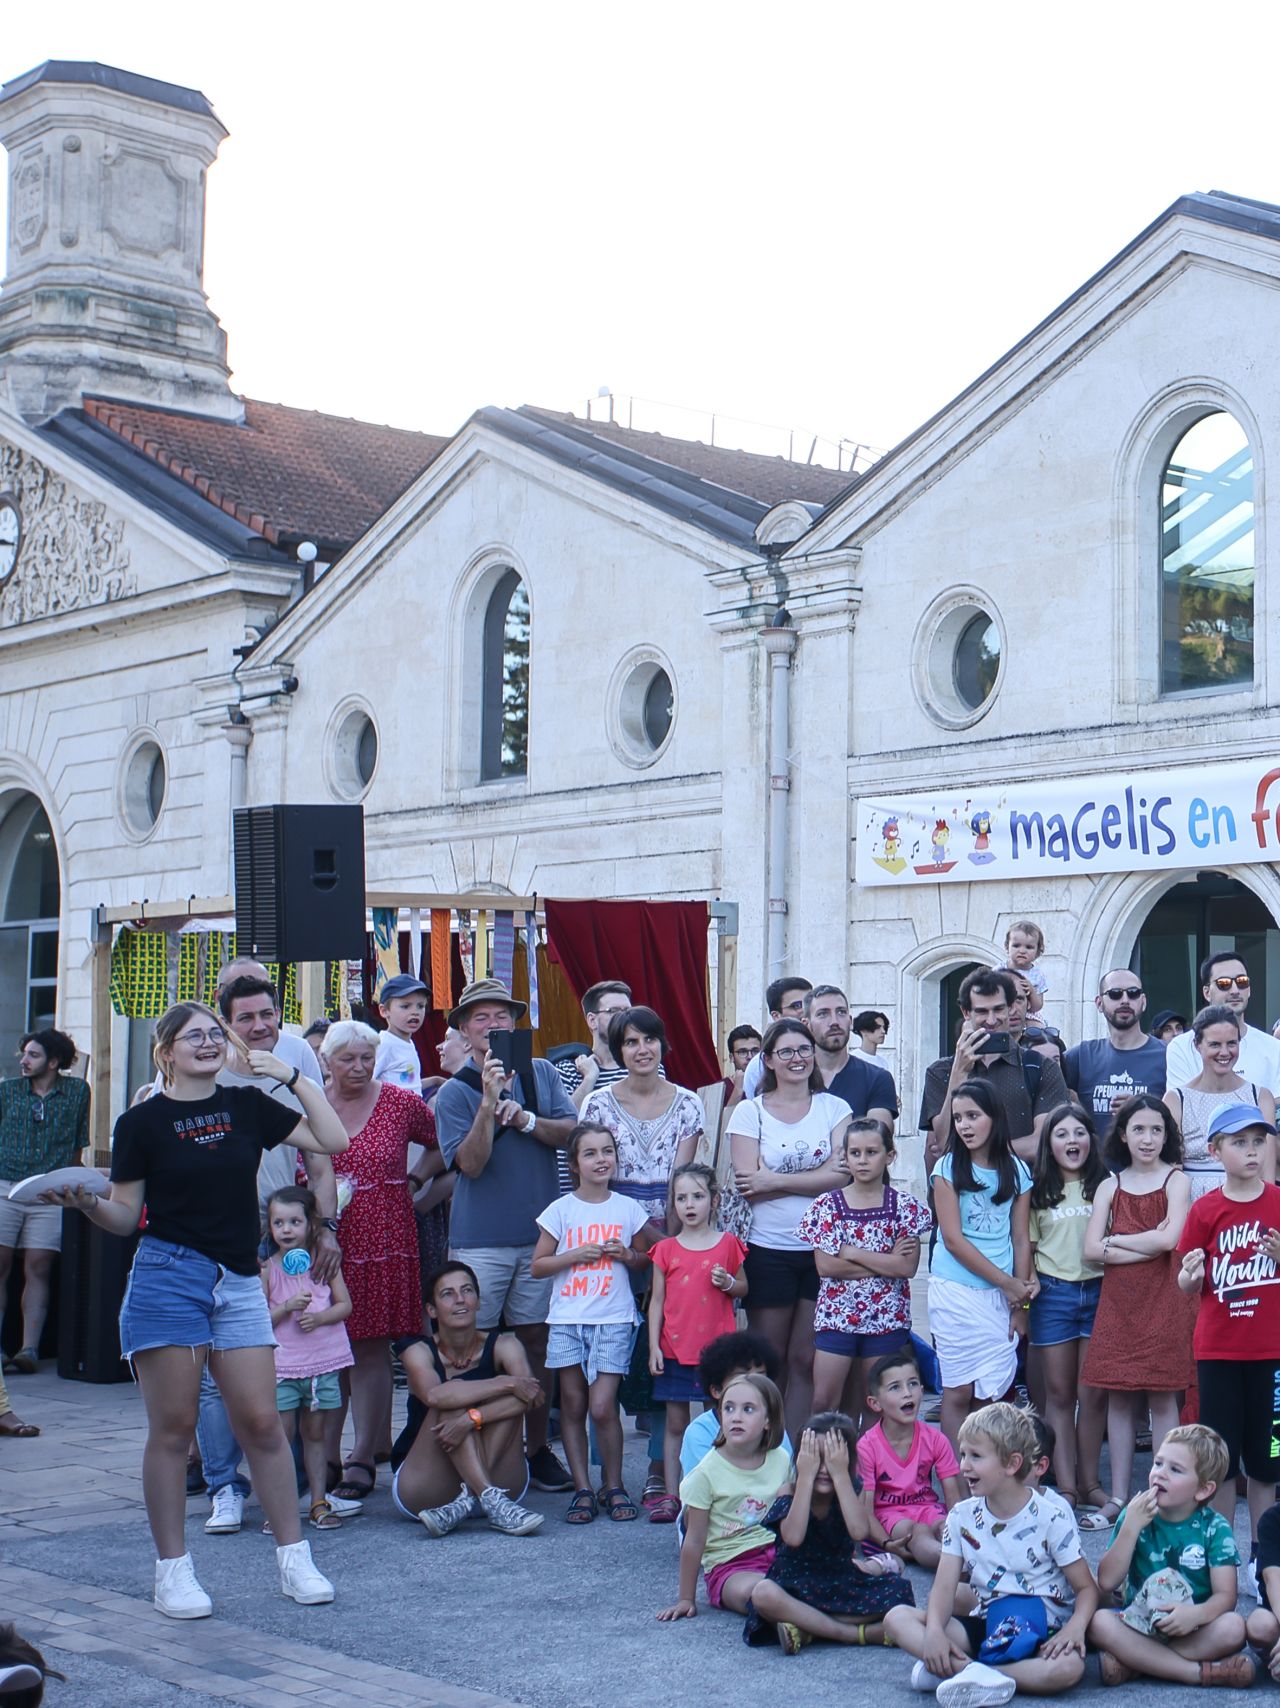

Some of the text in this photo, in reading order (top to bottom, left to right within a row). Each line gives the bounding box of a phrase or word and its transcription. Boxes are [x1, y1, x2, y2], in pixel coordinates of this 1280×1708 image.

[1188, 797, 1237, 848] en
[173, 1112, 231, 1133] NARUTO
[567, 1223, 623, 1249] I LOVE
[1219, 1220, 1260, 1254] Wild
[1212, 1246, 1279, 1303] Youth
